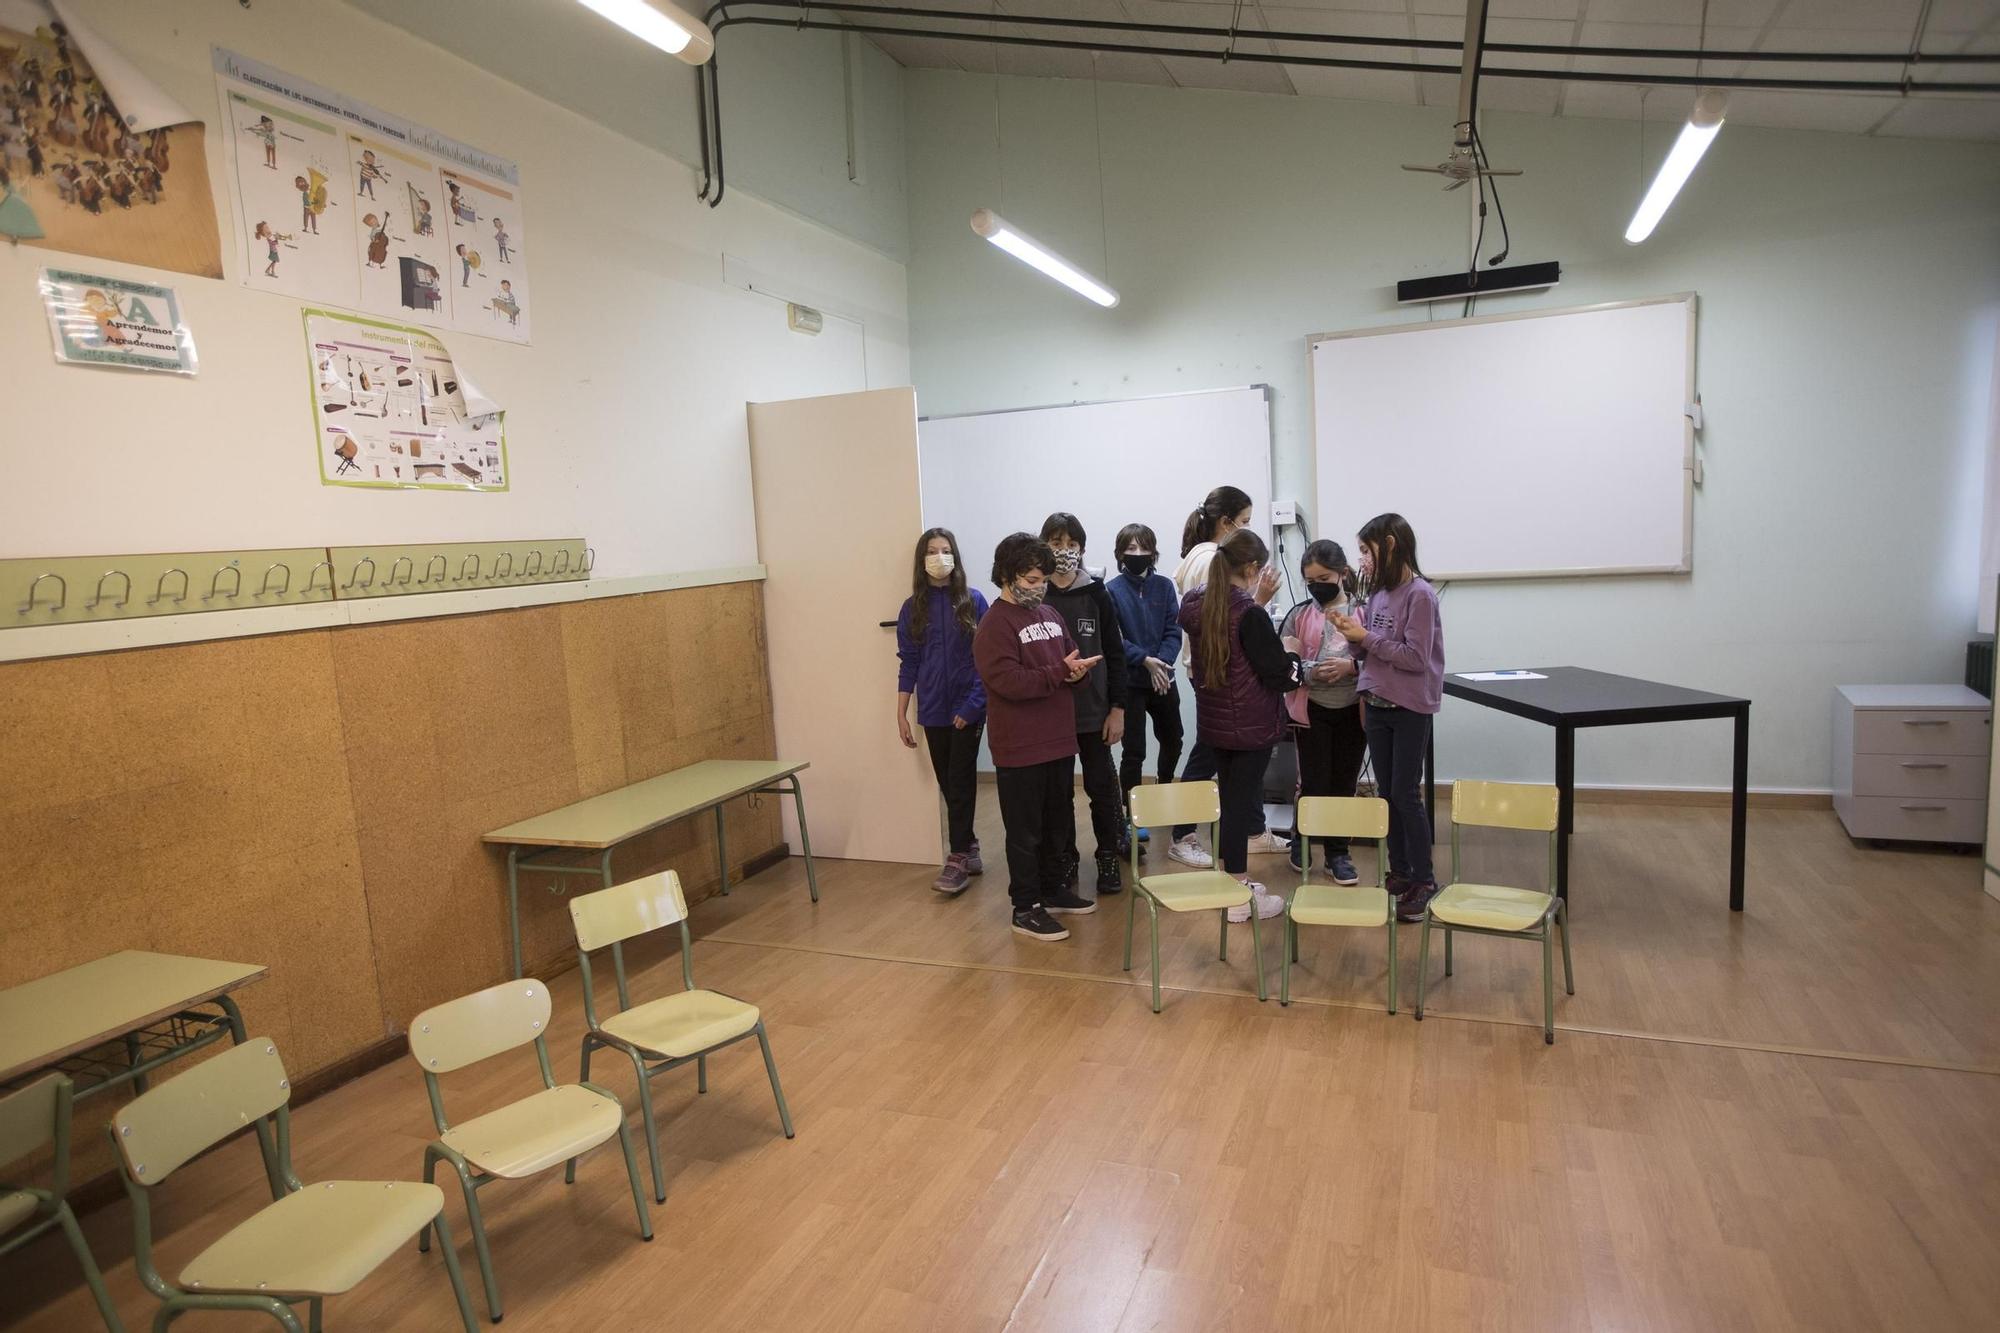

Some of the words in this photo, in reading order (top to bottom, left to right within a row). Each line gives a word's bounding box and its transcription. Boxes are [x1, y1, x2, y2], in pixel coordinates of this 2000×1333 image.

[291, 91, 302, 101] LOS
[126, 297, 160, 326] A
[107, 319, 173, 336] Aprendemos
[104, 336, 177, 351] Agradecemos
[361, 329, 412, 346] Instrumentos
